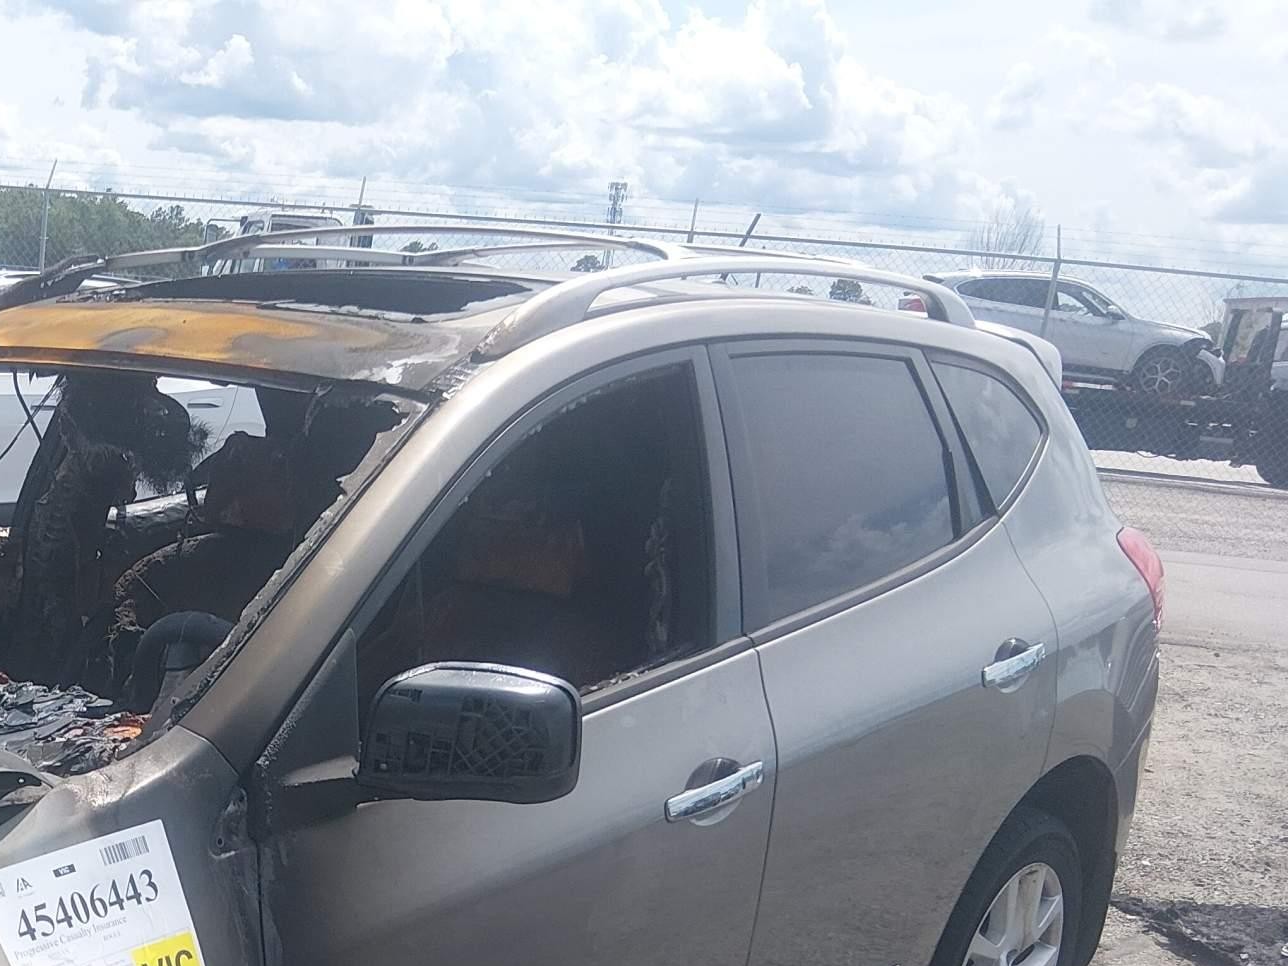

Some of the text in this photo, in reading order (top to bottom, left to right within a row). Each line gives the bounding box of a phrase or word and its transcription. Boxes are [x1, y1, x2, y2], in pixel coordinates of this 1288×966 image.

[17, 869, 159, 941] 45406443
[14, 937, 60, 961] Progressive
[59, 924, 93, 945] Casualty
[92, 916, 127, 933] Insurance
